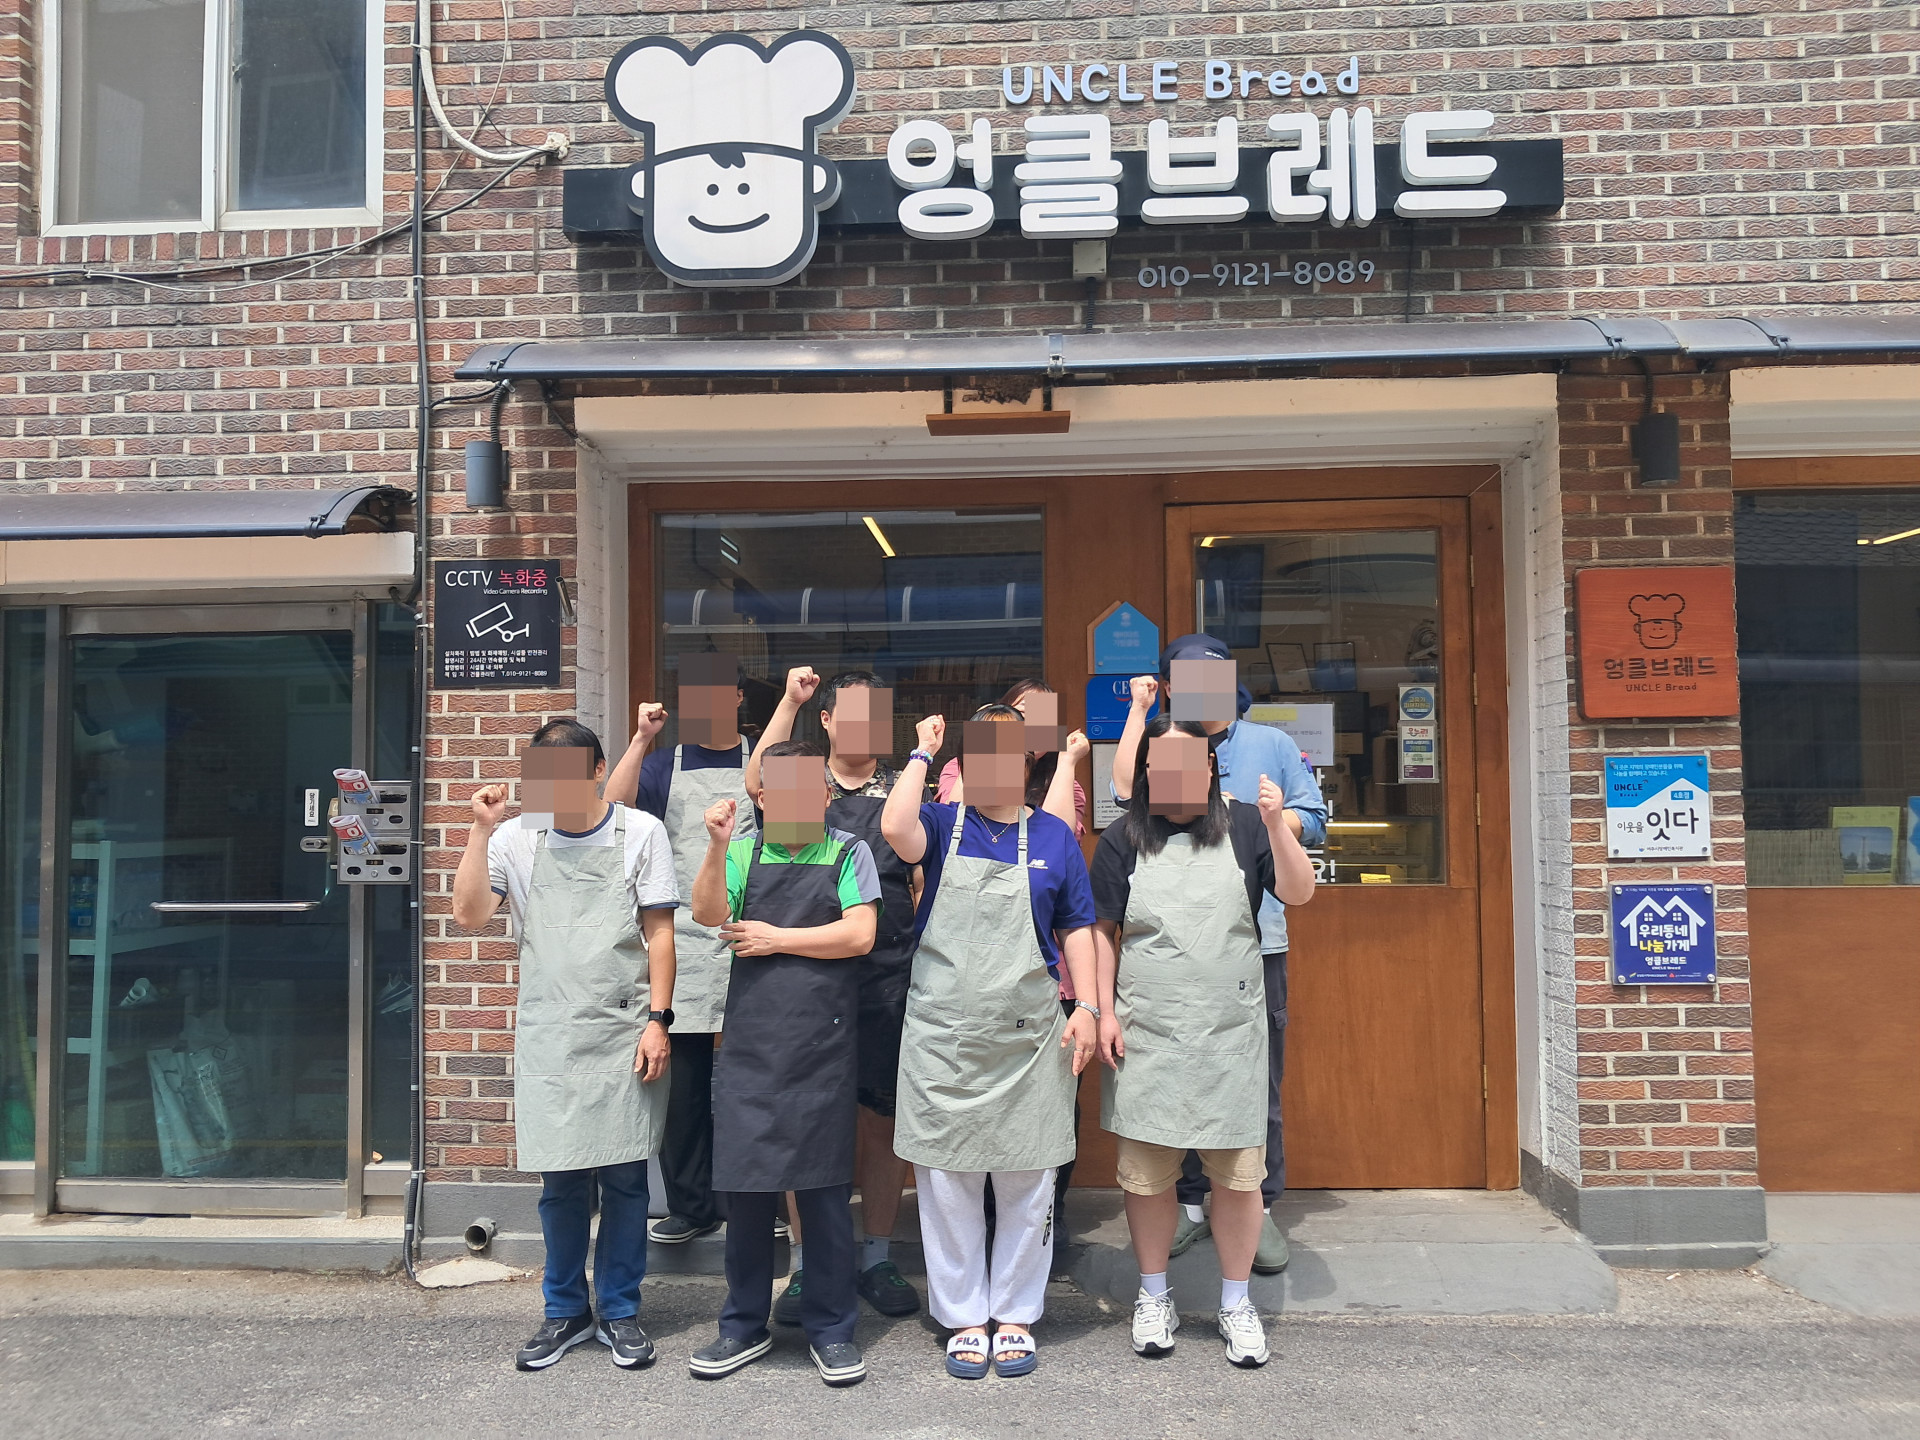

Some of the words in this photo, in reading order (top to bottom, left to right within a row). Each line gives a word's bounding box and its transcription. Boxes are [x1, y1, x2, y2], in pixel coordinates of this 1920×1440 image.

[1002, 61, 1180, 104] UNCLE
[1205, 55, 1359, 100] Bread
[887, 106, 1507, 240] 엉클브레드
[1138, 258, 1375, 289] 010-9121-8089
[445, 570, 493, 587] CCTV
[498, 569, 548, 587] 녹화중
[1604, 656, 1717, 680] 엉클브레드
[1625, 683, 1661, 692] UNCLE
[1665, 682, 1697, 691] Bread
[1614, 783, 1643, 791] UNCLE
[1673, 791, 1690, 800] 4호점
[1617, 821, 1644, 834] 이웃을
[1646, 807, 1700, 841] 잇다
[1639, 924, 1688, 939] 우리동네
[1639, 939, 1690, 953] 나눔가게
[1645, 956, 1687, 966] 엉클브레드
[955, 1337, 980, 1346] FILA
[1000, 1335, 1025, 1345] FILA
